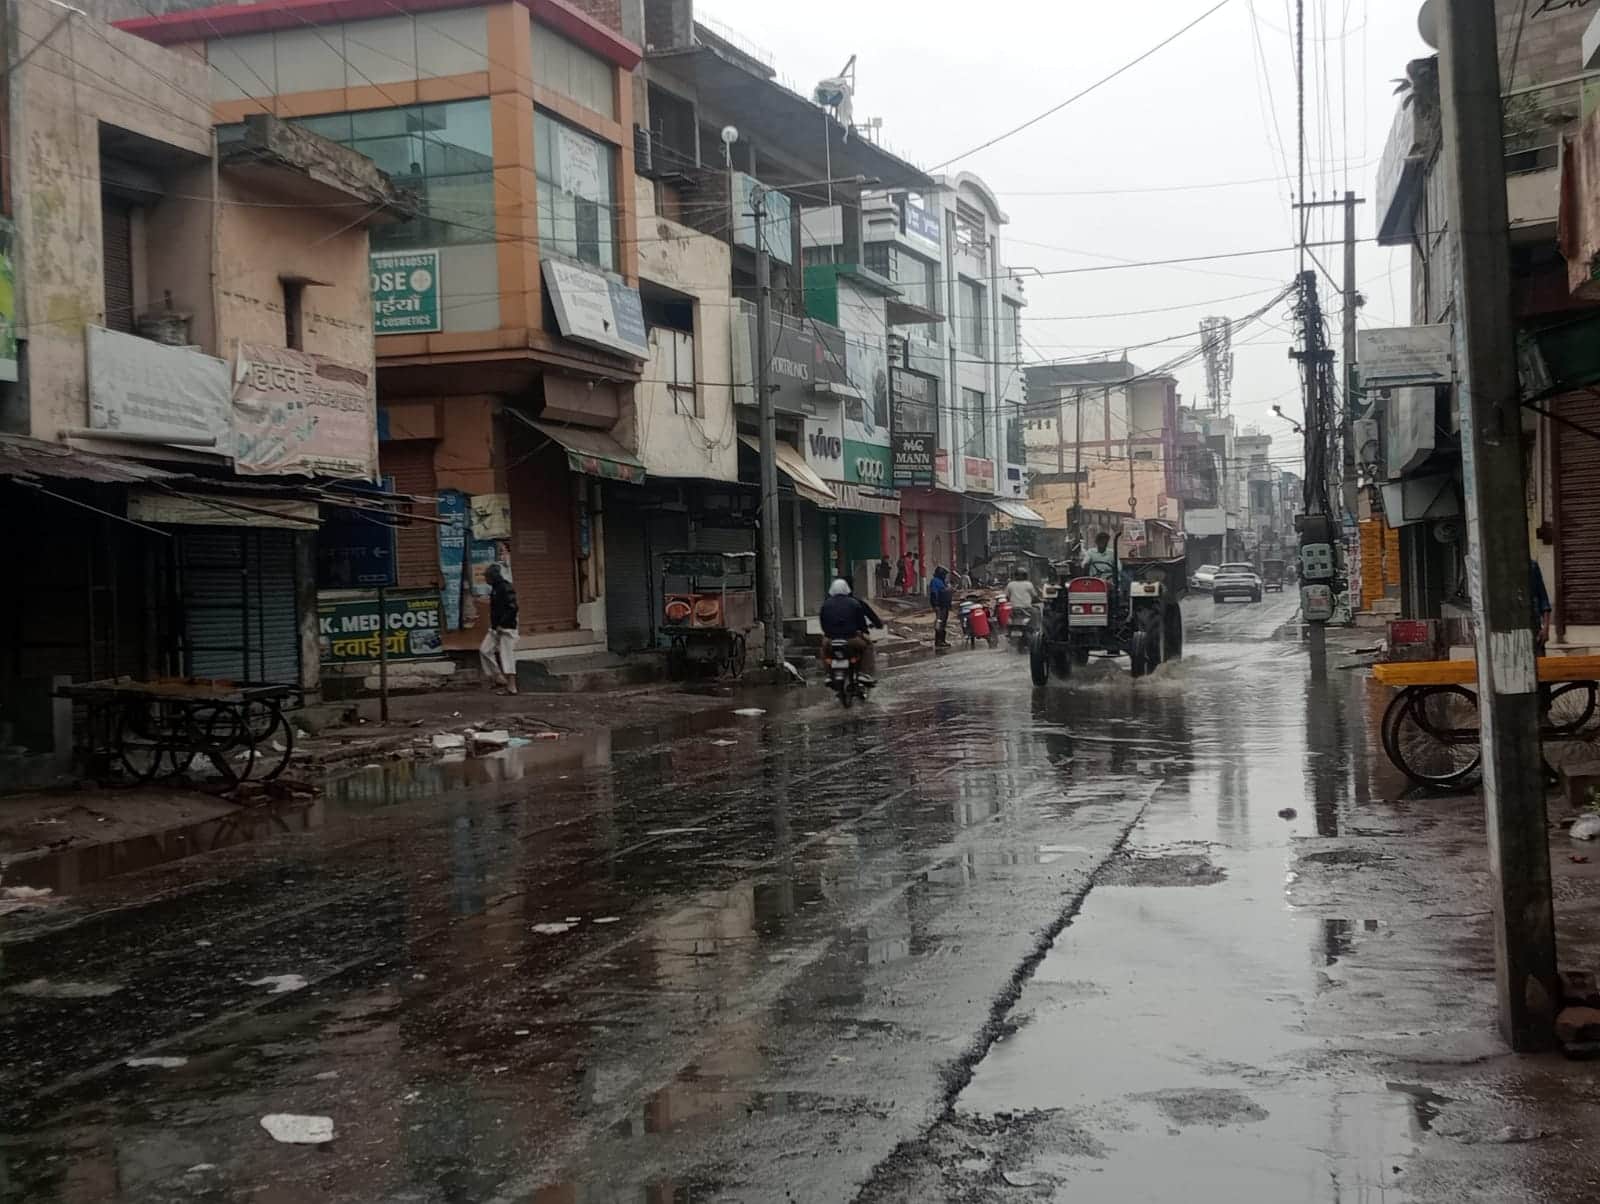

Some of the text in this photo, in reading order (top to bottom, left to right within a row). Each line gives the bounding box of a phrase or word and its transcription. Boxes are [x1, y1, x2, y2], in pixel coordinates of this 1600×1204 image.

[809, 427, 841, 459] vivo
[856, 457, 884, 481] oppo
[895, 453, 930, 464] MANN
